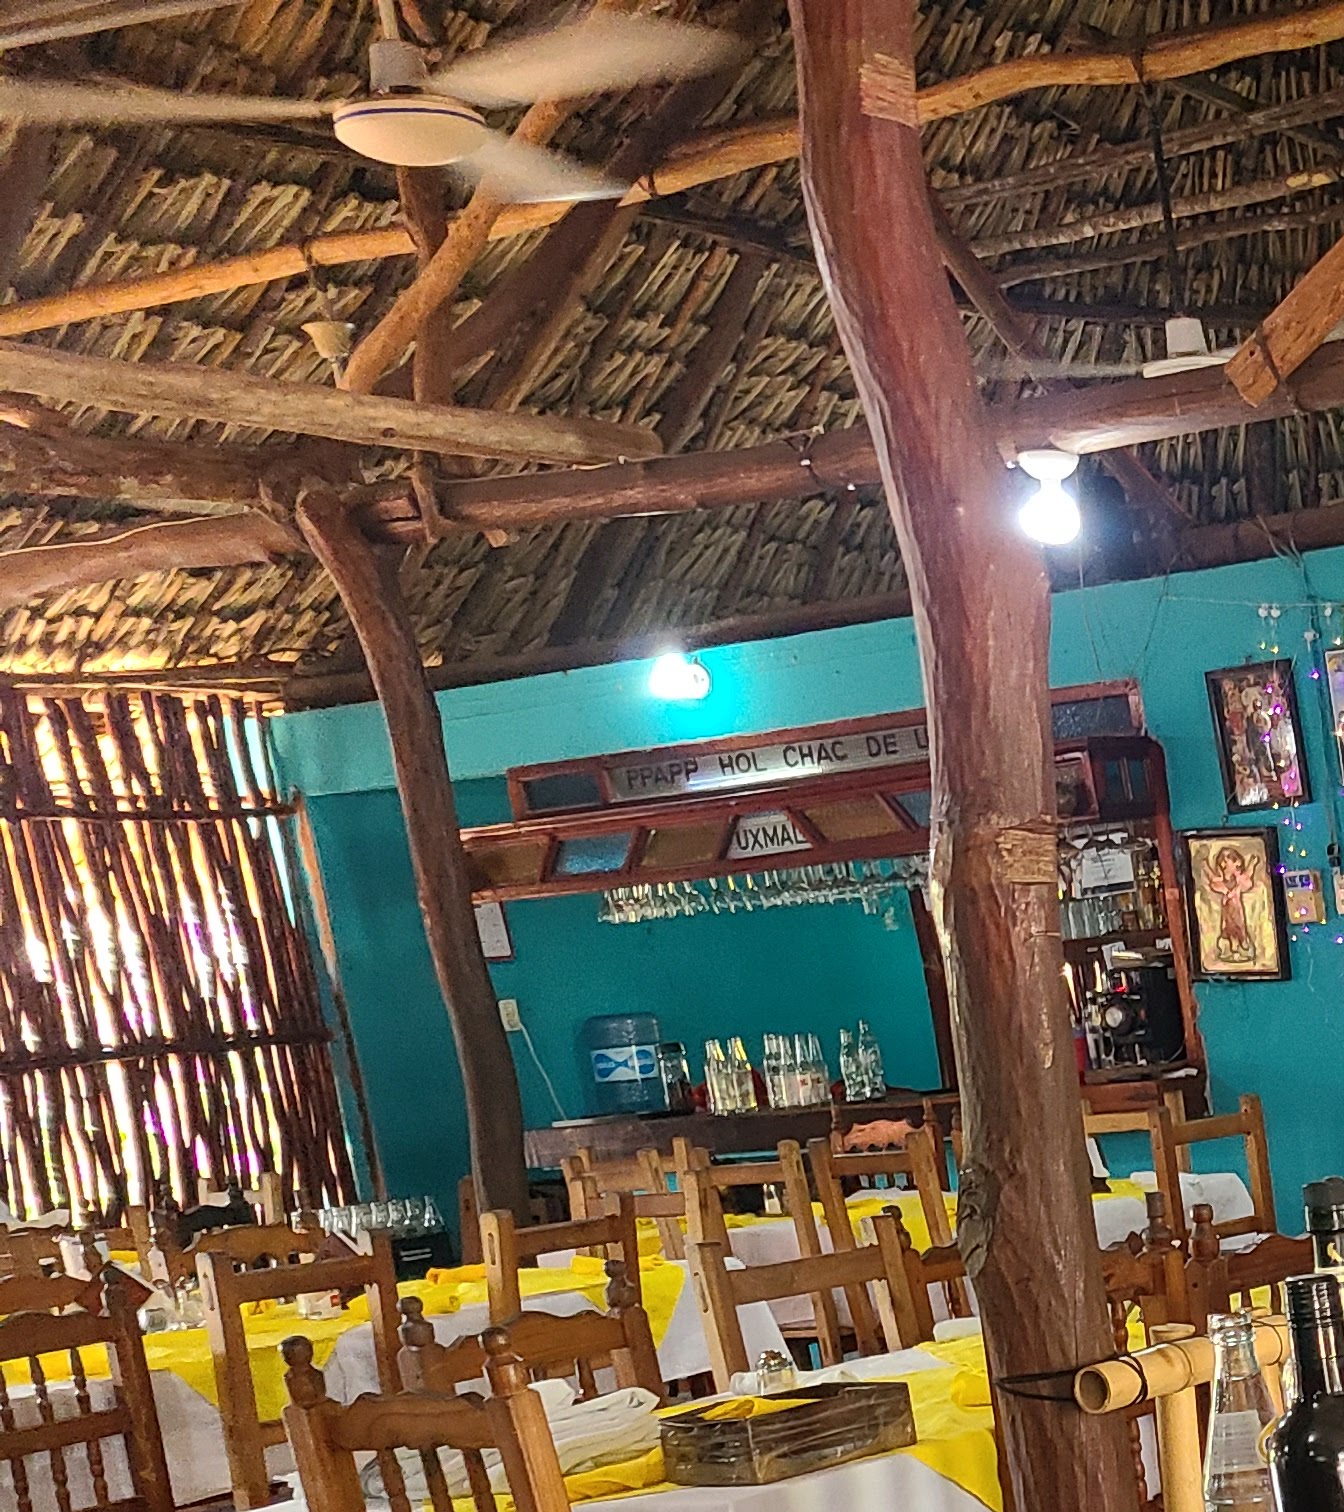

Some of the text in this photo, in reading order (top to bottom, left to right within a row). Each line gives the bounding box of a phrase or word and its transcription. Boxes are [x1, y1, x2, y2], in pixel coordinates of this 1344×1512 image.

[718, 751, 767, 776] HOL
[782, 740, 848, 767] CHAC
[865, 733, 899, 757] DE
[736, 822, 807, 851] UXMAL
